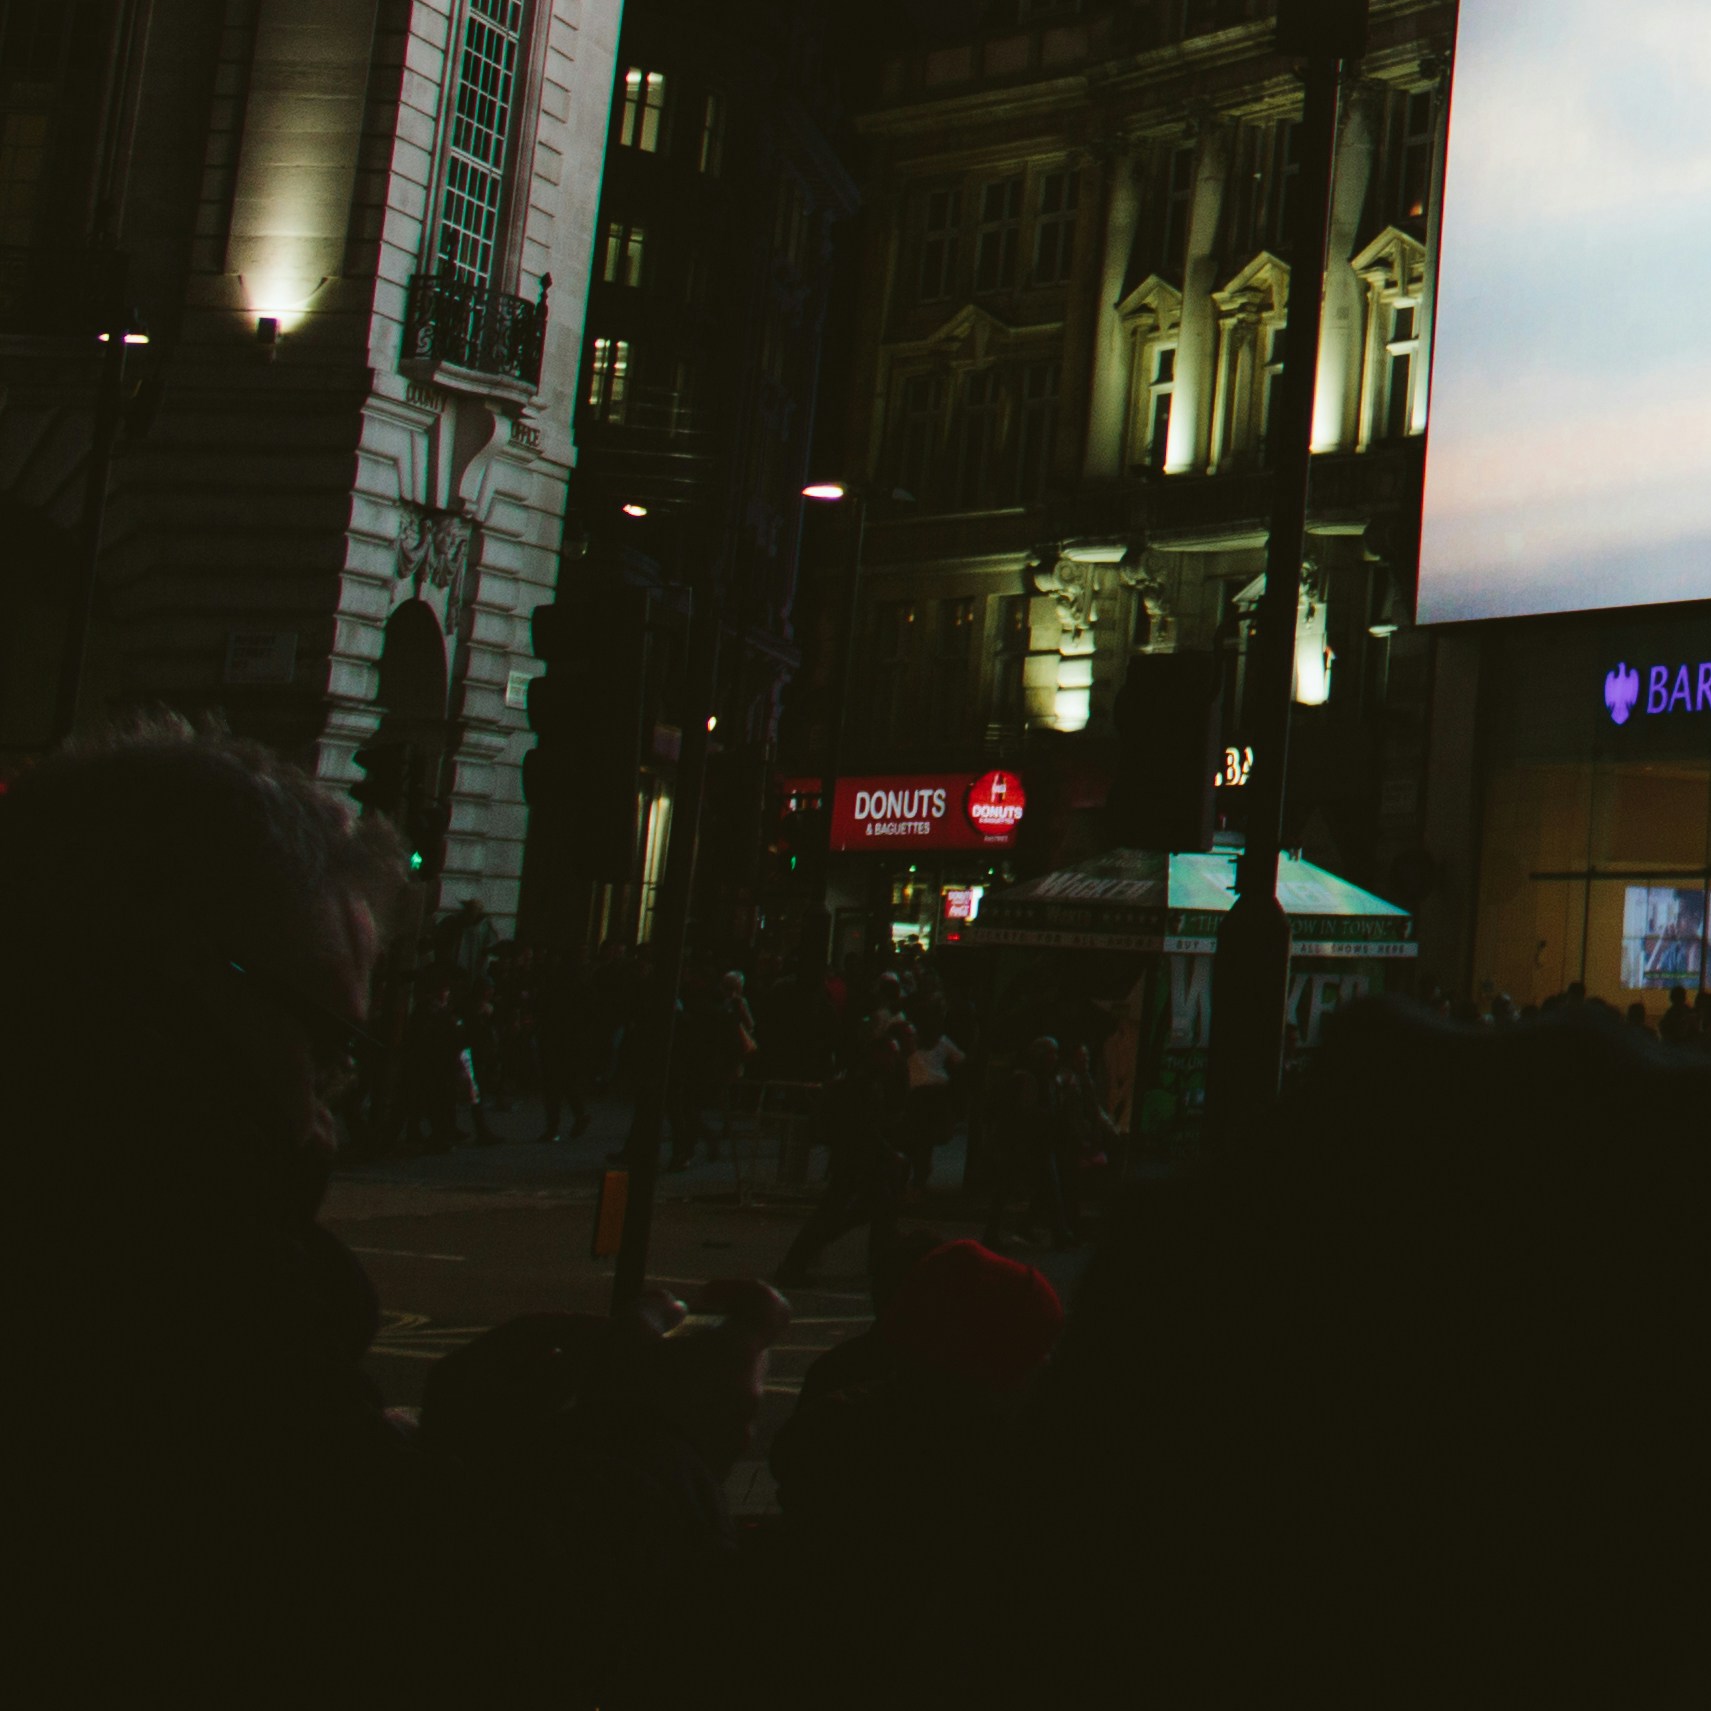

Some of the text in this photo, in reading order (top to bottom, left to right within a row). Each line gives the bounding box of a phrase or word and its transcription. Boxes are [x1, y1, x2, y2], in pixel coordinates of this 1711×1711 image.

[854, 788, 946, 820] DONUTS
[972, 803, 1023, 820] DONUTS
[874, 821, 931, 836] BAGUETTES
